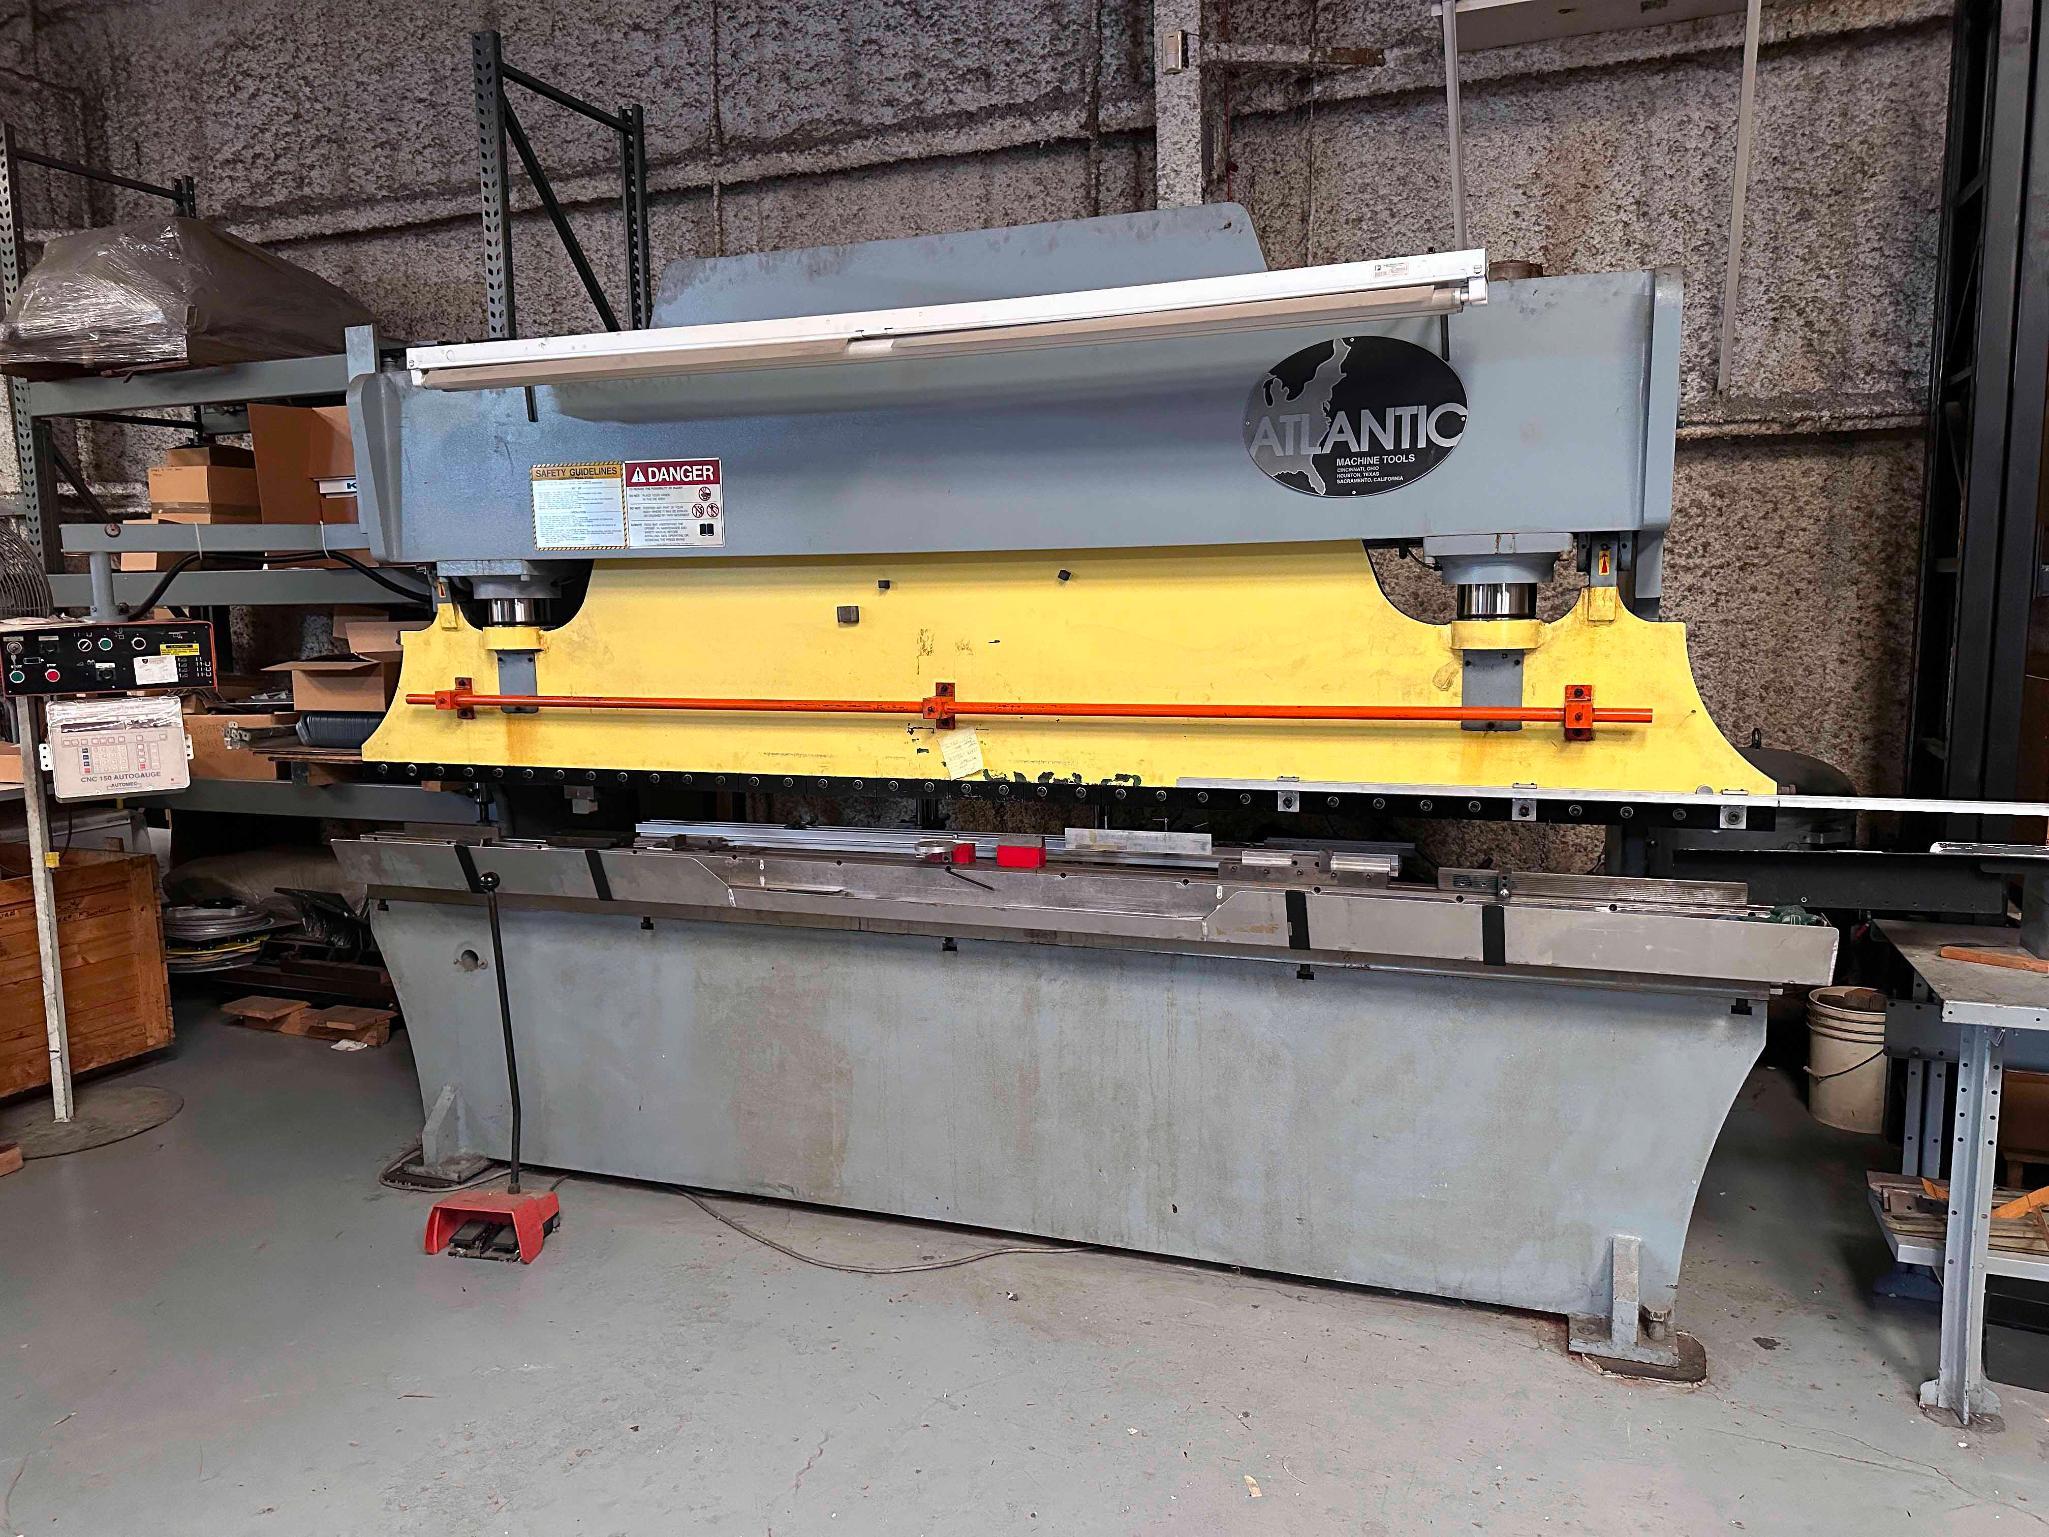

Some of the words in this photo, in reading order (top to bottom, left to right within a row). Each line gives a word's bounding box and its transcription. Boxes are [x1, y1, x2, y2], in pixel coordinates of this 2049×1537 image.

[1251, 402, 1468, 457] ATLANTIC
[1336, 456, 1380, 467] MACHINE
[1382, 453, 1415, 464] TOOLS
[536, 468, 566, 478] SAFETY
[569, 466, 618, 477] GUIDELINES
[648, 465, 714, 484] DANGER
[1373, 475, 1404, 483] CALIFORNIA
[113, 771, 161, 780] AUTOGAUGE
